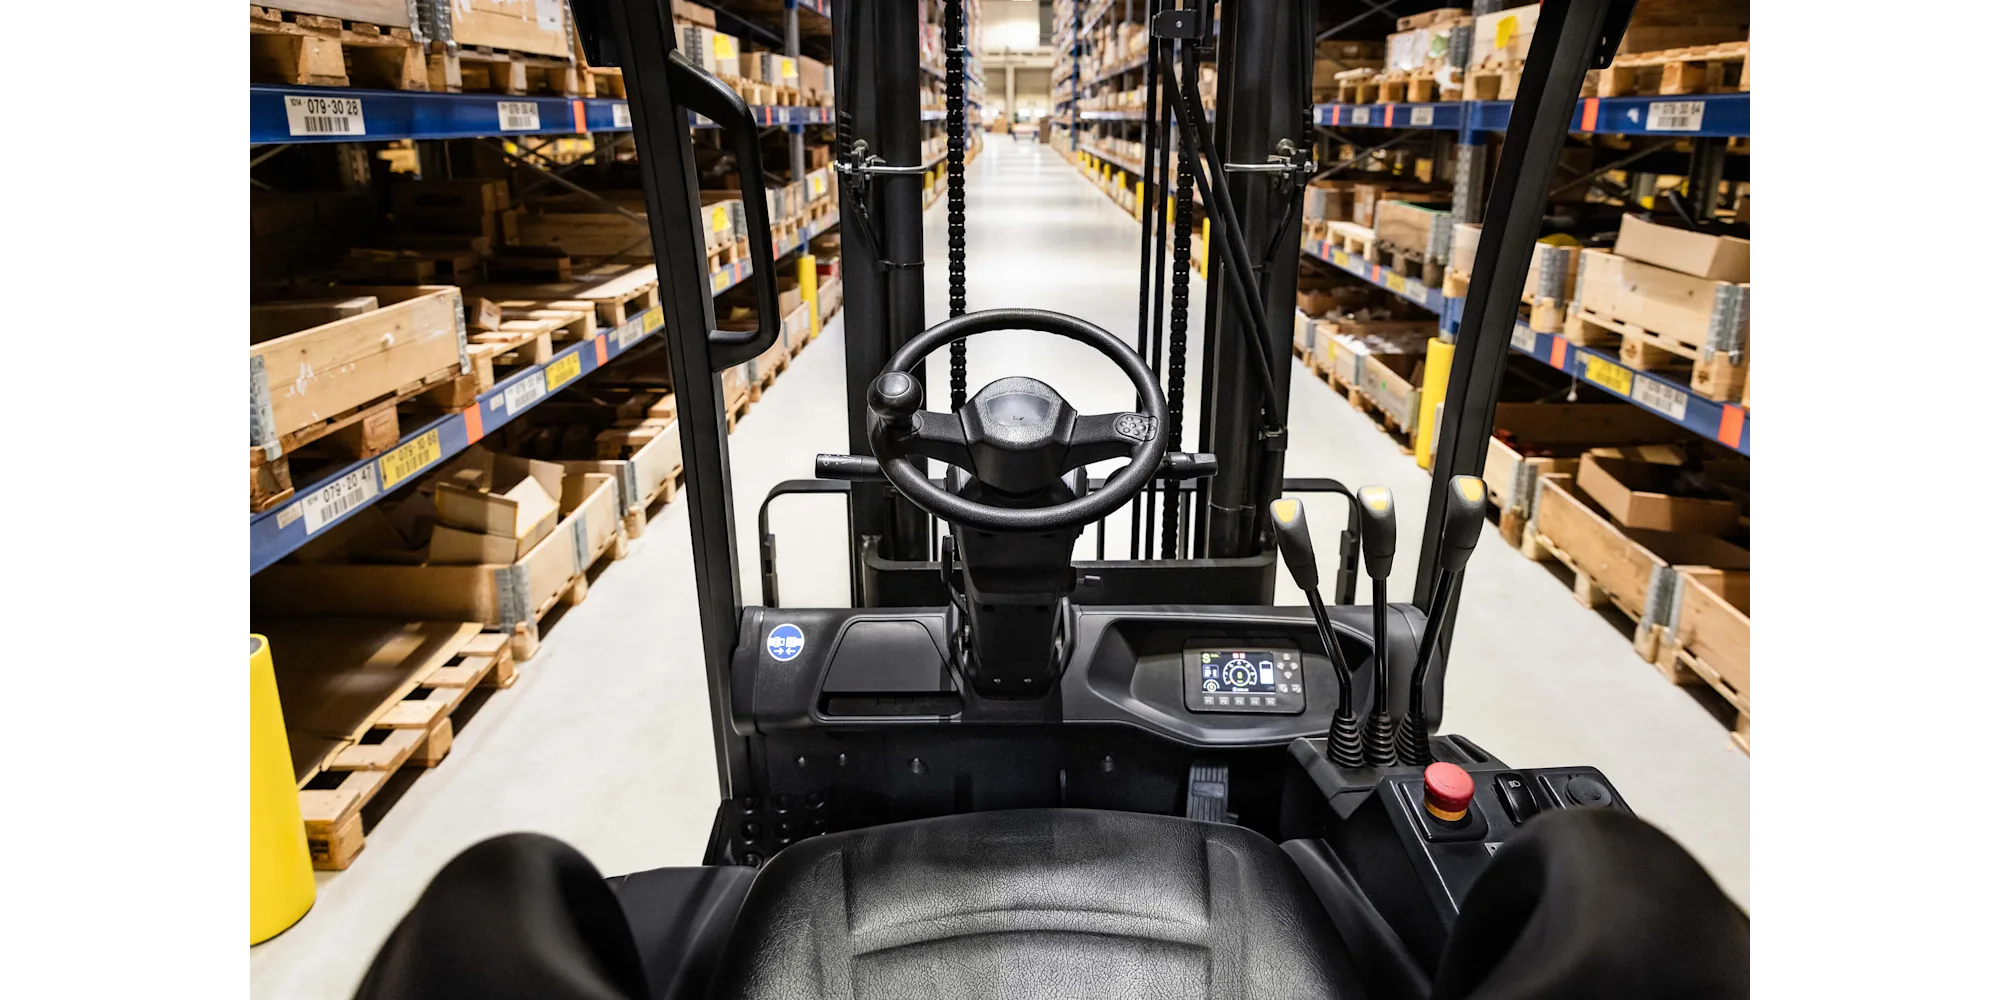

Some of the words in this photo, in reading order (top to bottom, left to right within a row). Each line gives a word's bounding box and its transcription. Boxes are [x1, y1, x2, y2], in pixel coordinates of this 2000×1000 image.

[307, 98, 344, 114] 079-30
[346, 100, 359, 115] 28
[323, 473, 358, 503] 079-20
[1202, 653, 1211, 664] S
